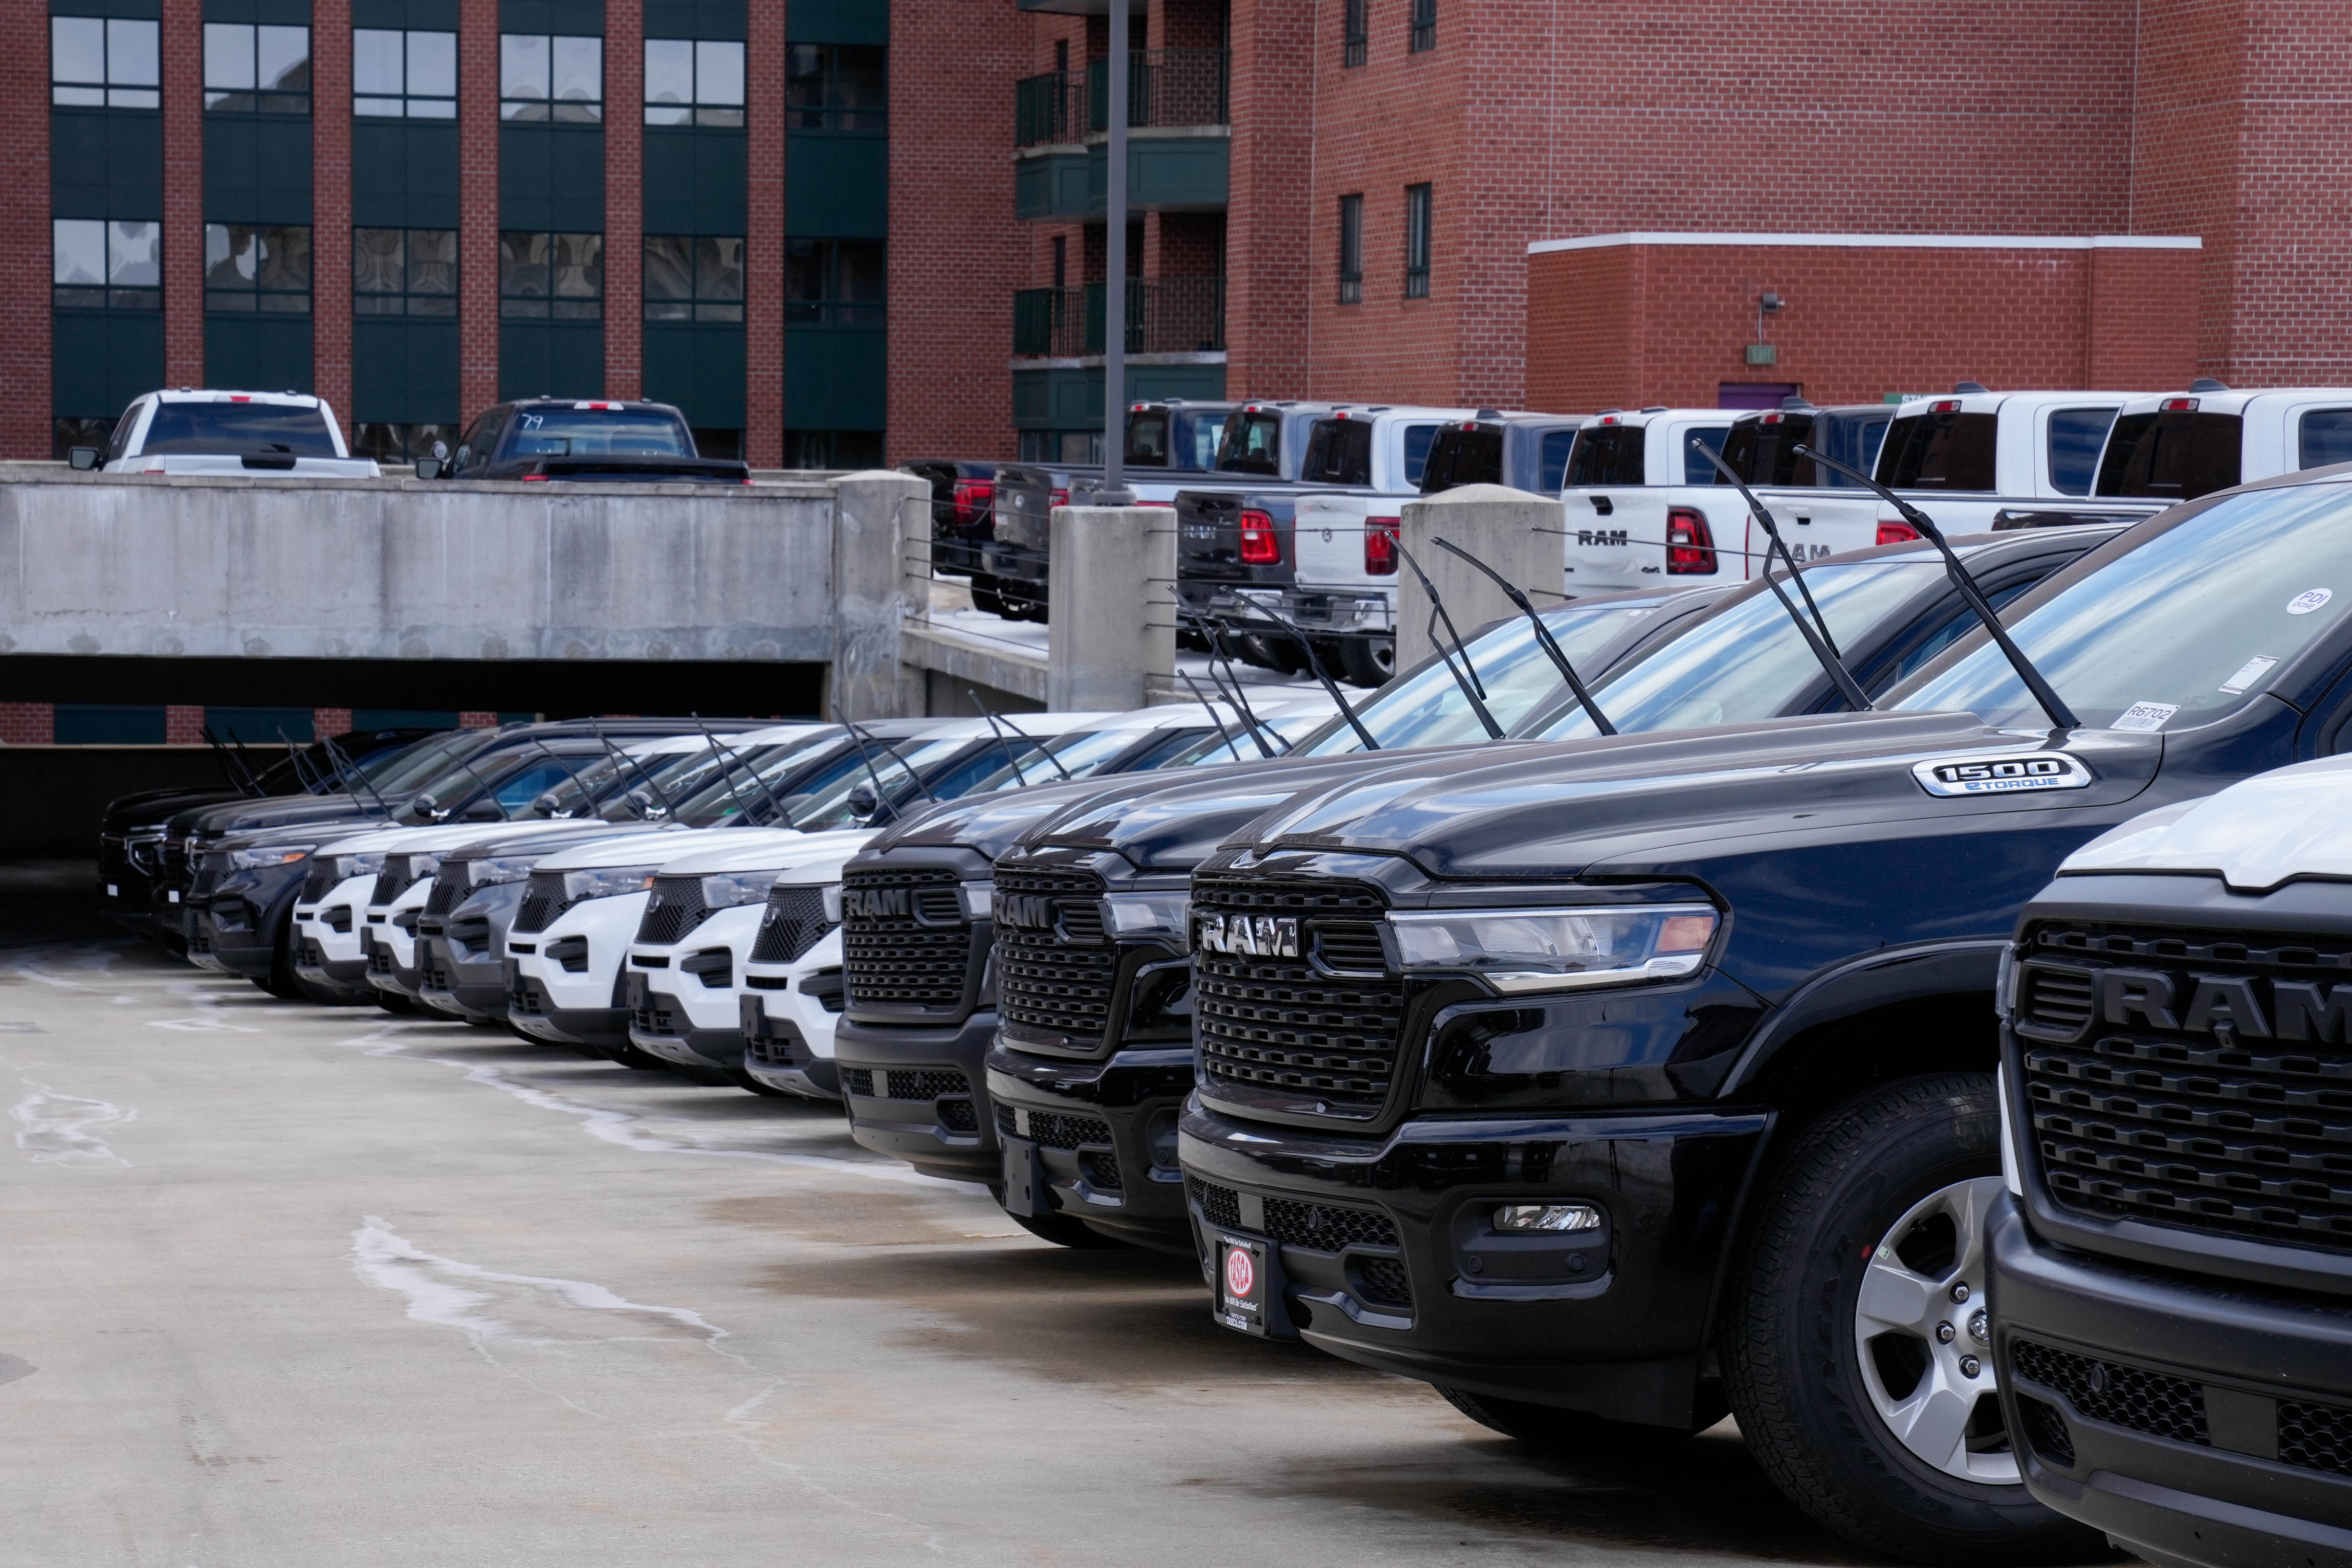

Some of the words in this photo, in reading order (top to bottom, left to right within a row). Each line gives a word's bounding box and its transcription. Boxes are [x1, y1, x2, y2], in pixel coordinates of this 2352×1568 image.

[522, 413, 543, 430] 79
[1578, 530, 1628, 546] RAM
[2293, 601, 2316, 609] DONE
[2299, 592, 2329, 604] PDI
[2127, 706, 2172, 720] R6702
[1939, 760, 2060, 782] 1500
[847, 889, 909, 916] RAM
[993, 895, 1050, 929] RAM
[1201, 912, 1299, 958] RAM
[2103, 971, 2352, 1044] RAM
[1230, 1253, 1249, 1290] TASCA
[1226, 1316, 1247, 1331] TASCA.COM
